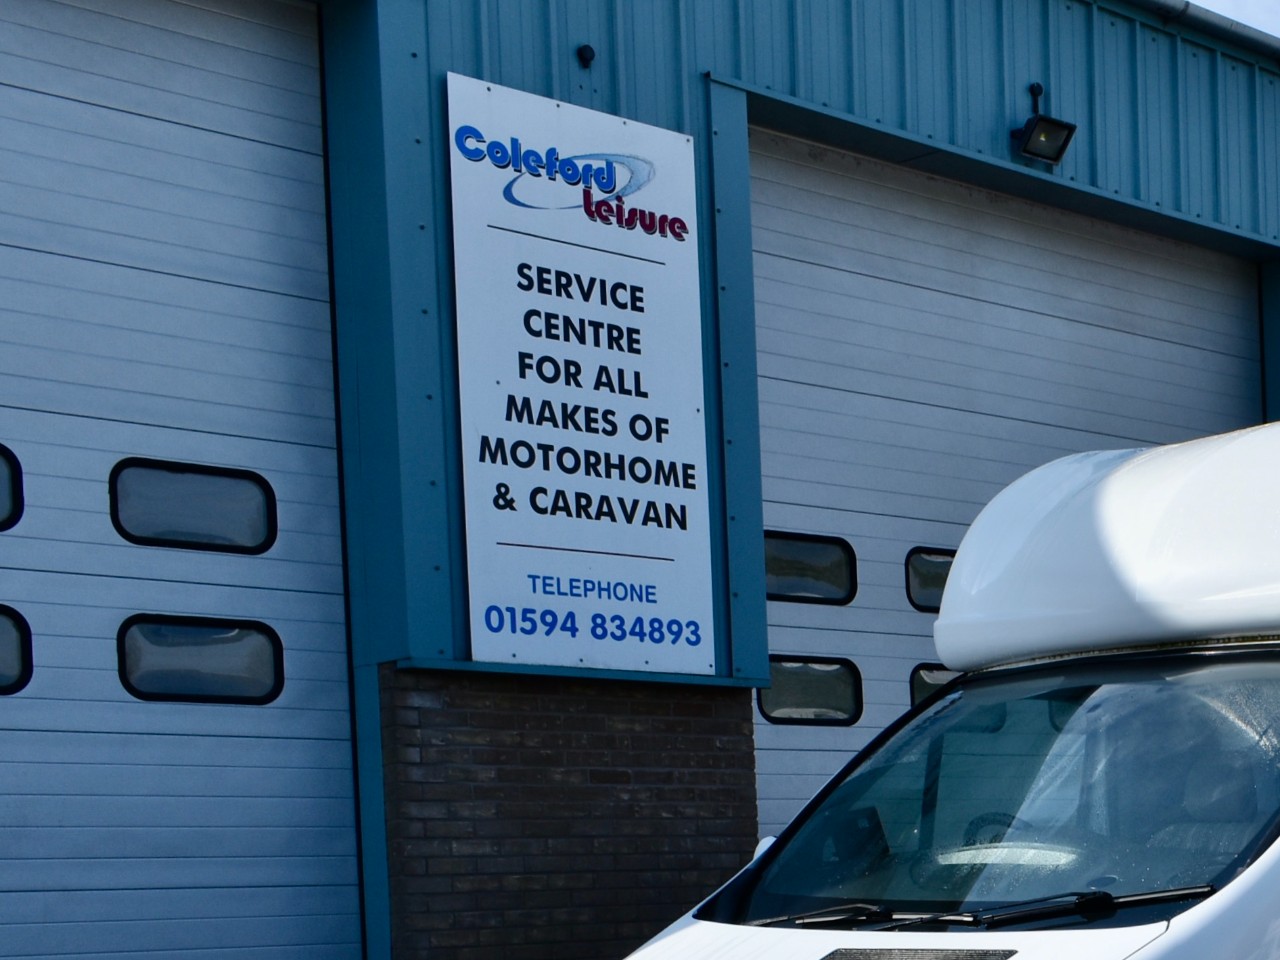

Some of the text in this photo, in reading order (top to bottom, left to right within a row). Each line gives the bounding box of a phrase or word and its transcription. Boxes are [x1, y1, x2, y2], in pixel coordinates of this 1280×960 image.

[454, 124, 617, 193] Coleford
[516, 262, 645, 313] SERVICE
[523, 308, 642, 355] CENTRE
[517, 351, 649, 399] FOR ALL
[505, 394, 670, 444] MAKES OF
[478, 435, 697, 490] MOTORHOME
[492, 482, 688, 531] & CARAVAN
[527, 574, 658, 604] TELEPHONE
[484, 605, 702, 647] 01594 834893
